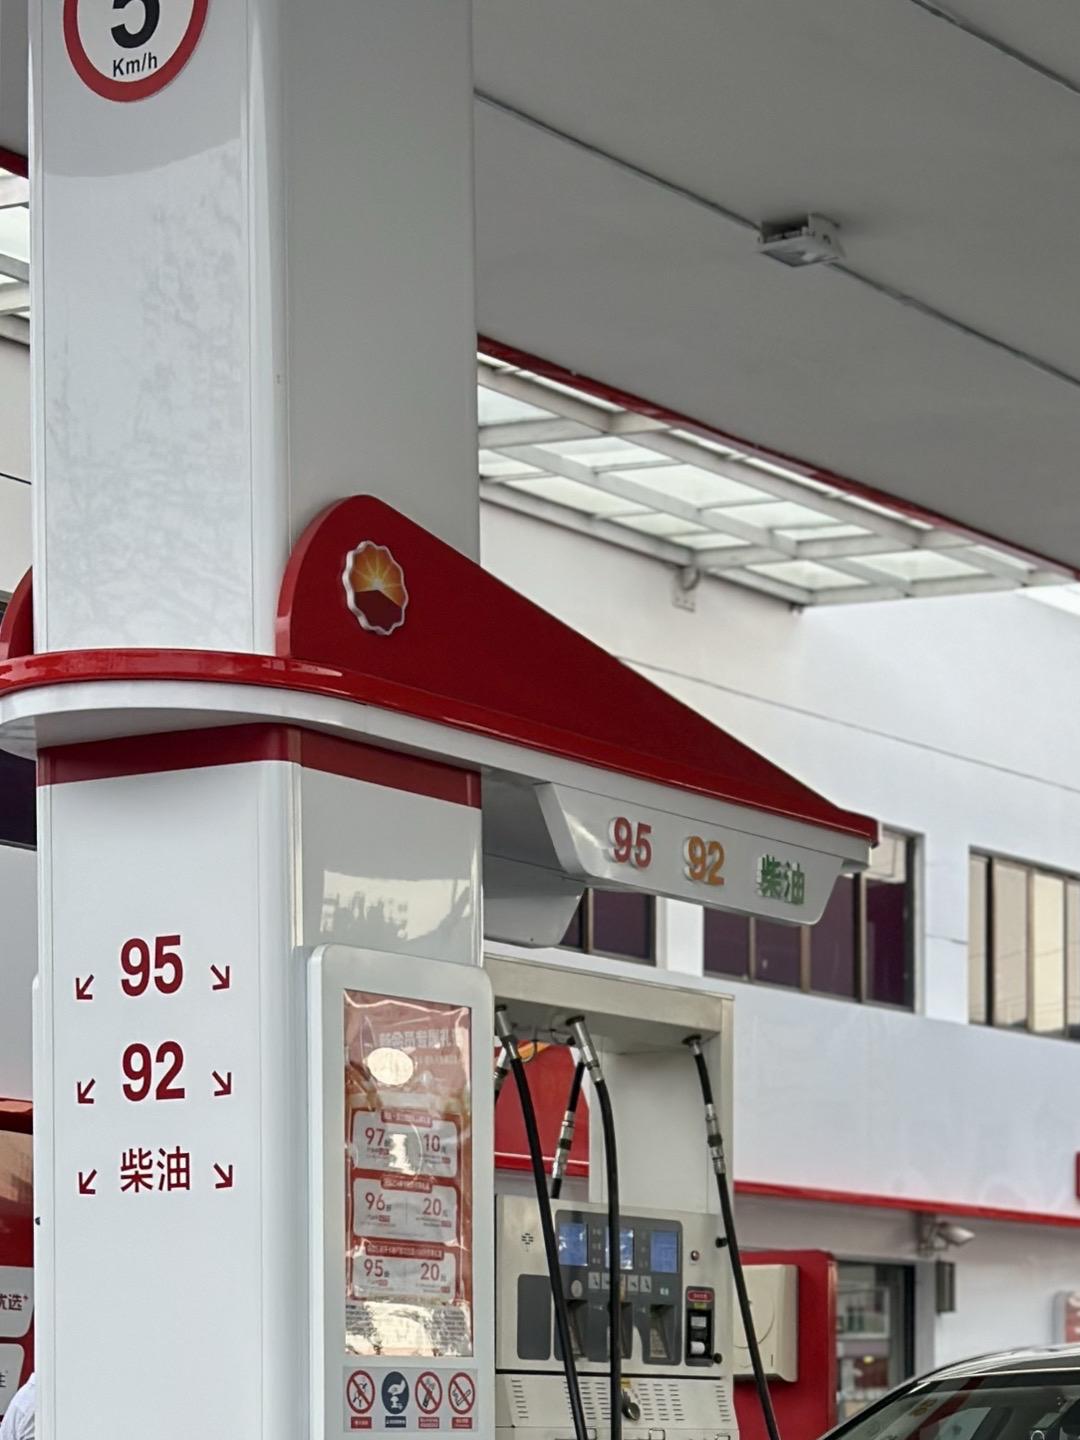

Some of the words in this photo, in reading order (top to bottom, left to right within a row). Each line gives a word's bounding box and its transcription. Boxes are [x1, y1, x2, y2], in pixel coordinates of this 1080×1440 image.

[111, 0, 160, 48] 5
[113, 52, 157, 77] Km/h
[610, 817, 652, 869] 95
[684, 836, 725, 886] 92
[758, 854, 805, 904] 柴油
[120, 935, 184, 997] 95
[122, 1041, 186, 1102] 92
[120, 1146, 191, 1193] 柴油
